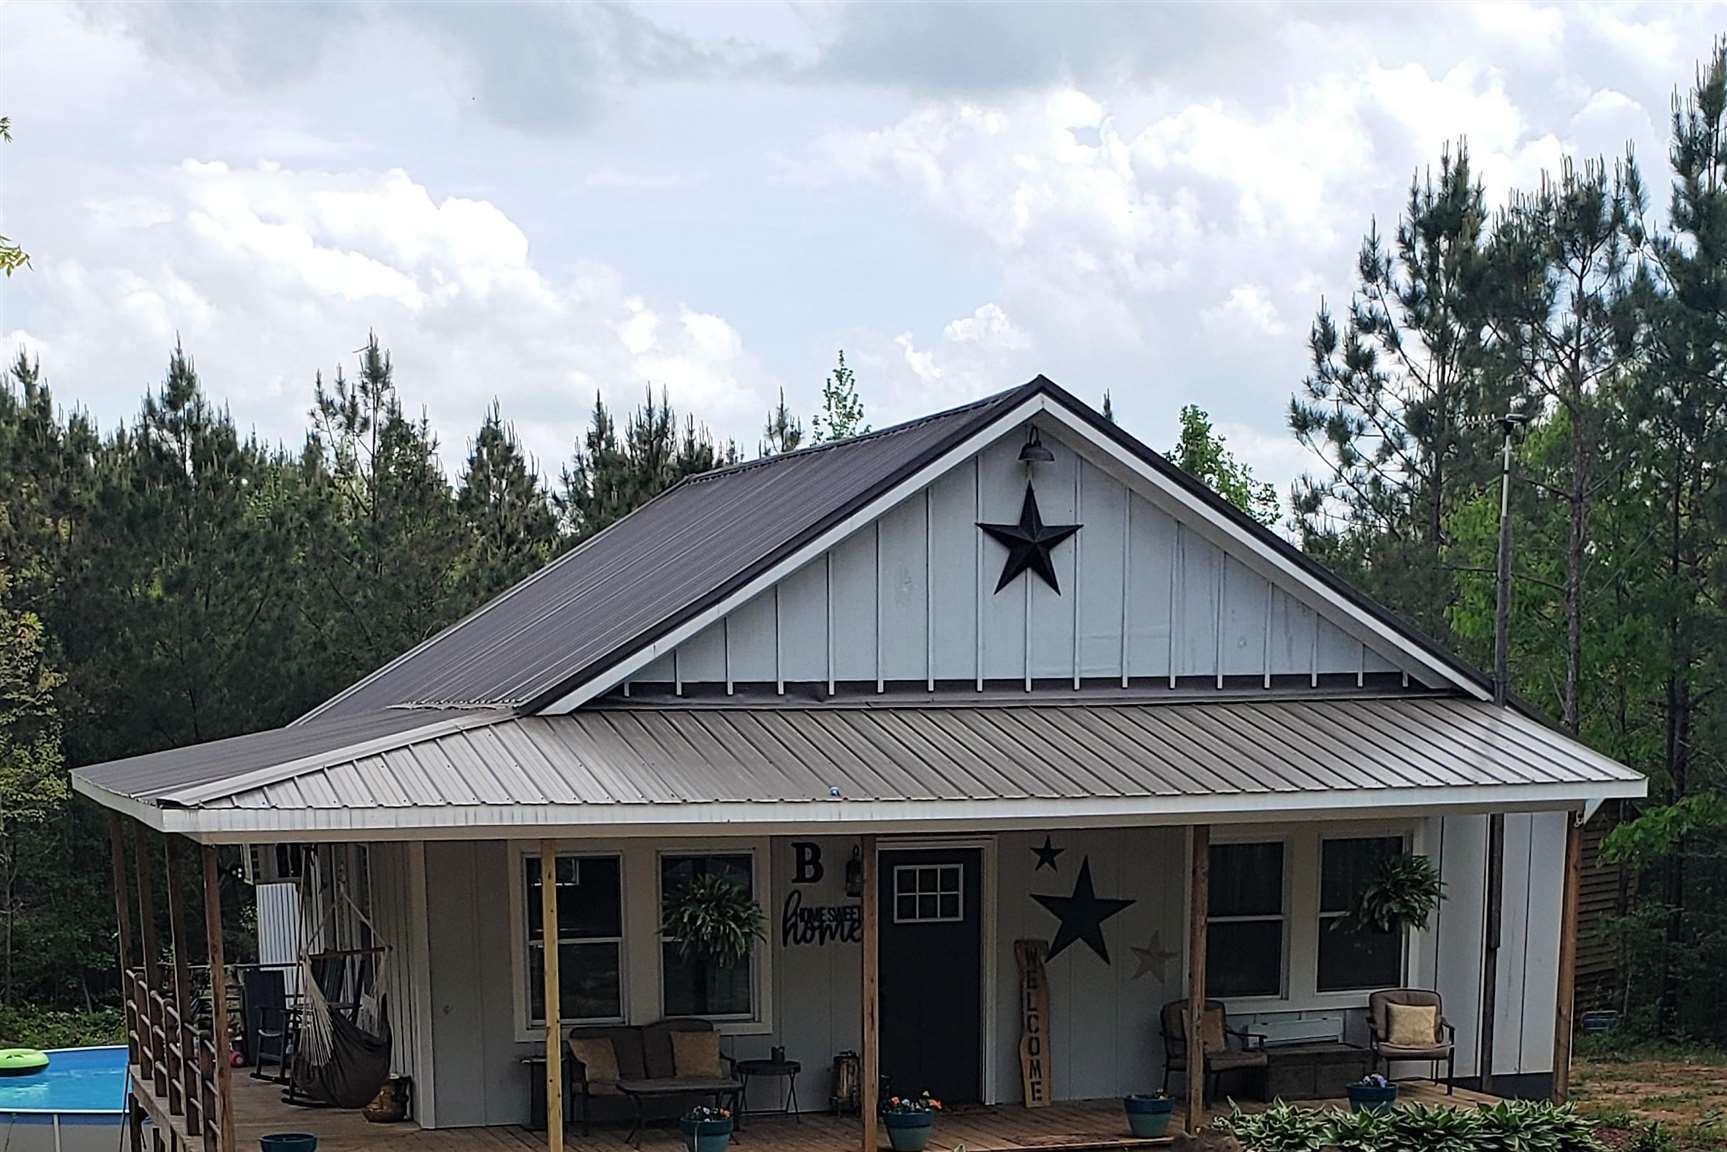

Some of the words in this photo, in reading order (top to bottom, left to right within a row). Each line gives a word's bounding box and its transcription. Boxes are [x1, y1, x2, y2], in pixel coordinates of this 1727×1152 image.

[791, 842, 824, 883] B
[782, 890, 862, 947] home
[1025, 945, 1043, 1102] WELCOME
